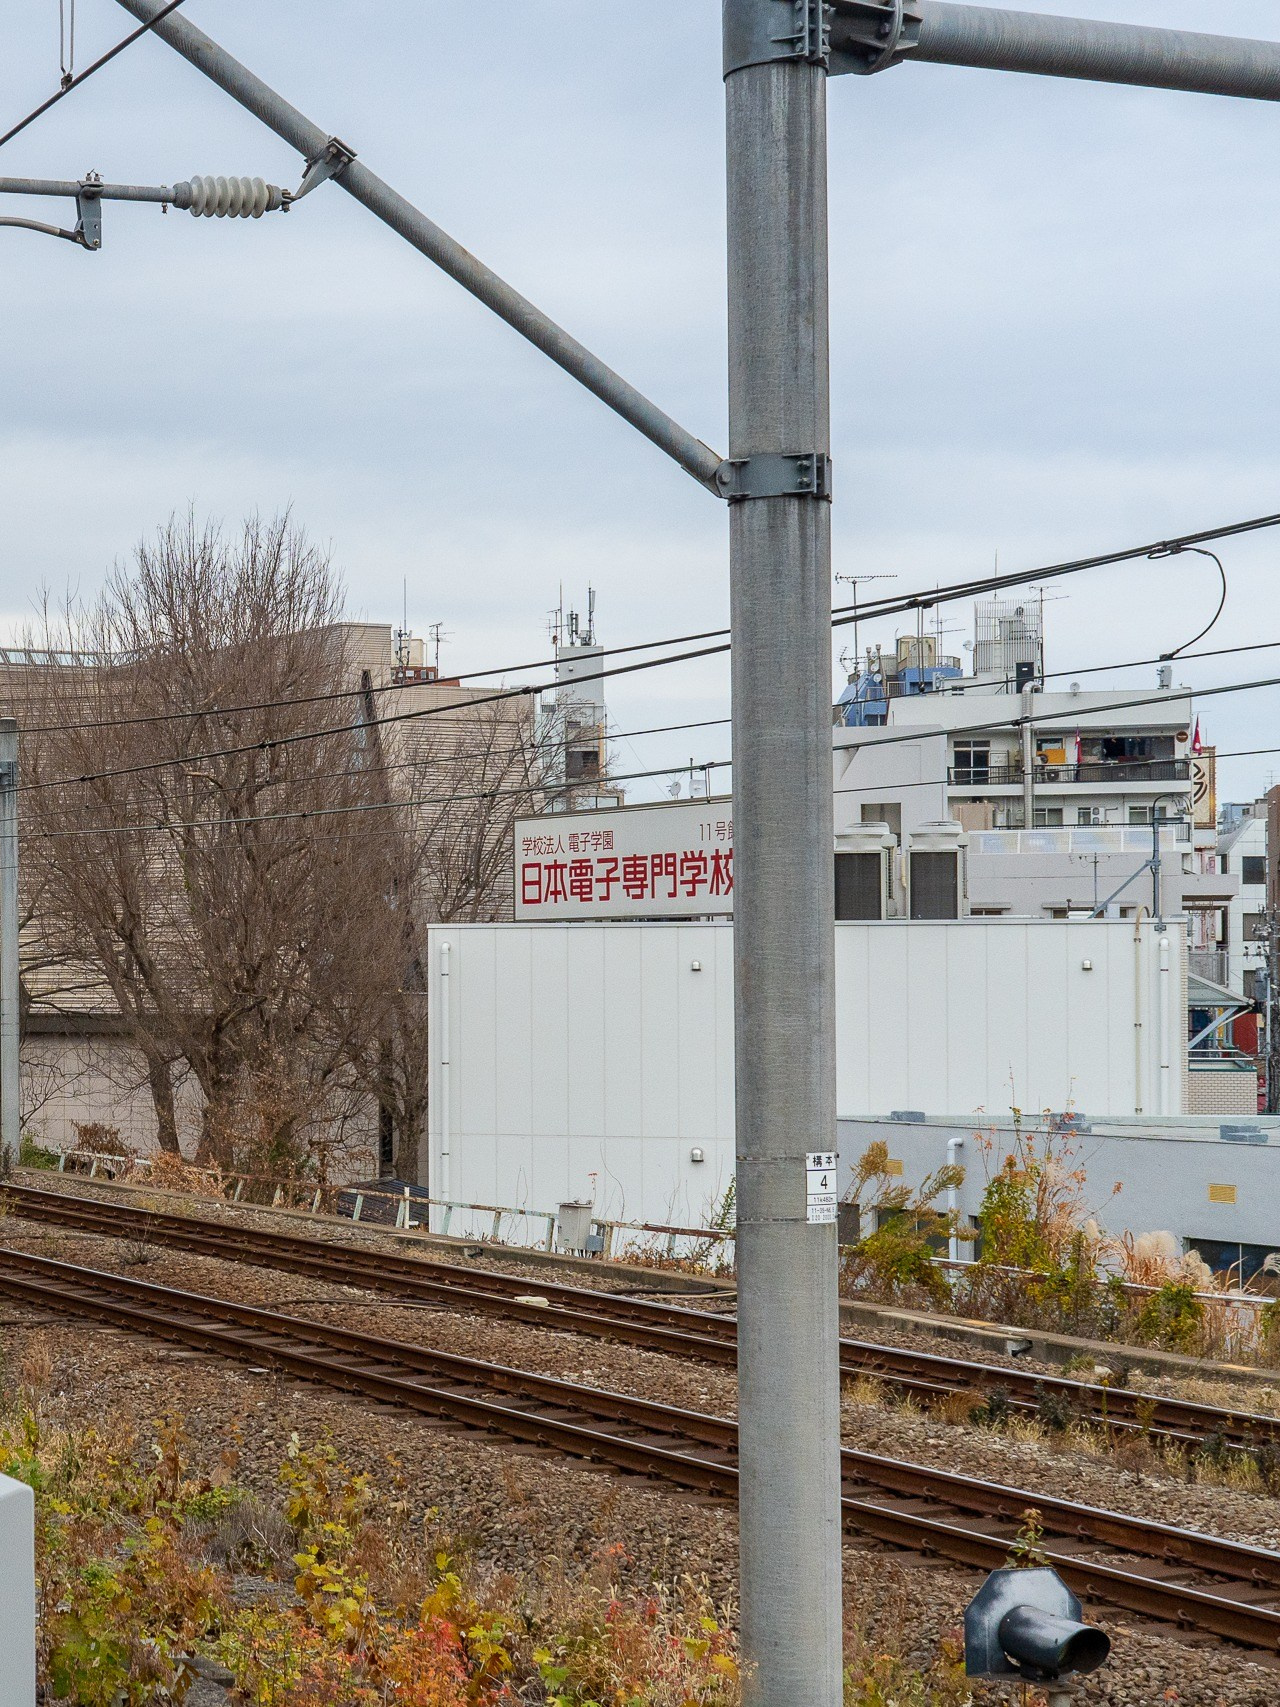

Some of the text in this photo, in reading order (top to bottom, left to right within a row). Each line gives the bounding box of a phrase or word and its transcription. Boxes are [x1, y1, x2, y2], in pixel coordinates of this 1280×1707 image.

[522, 830, 614, 857] 学校法人 電子学園
[521, 848, 733, 905] 日本電子専門学校
[820, 1174, 828, 1190] 4
